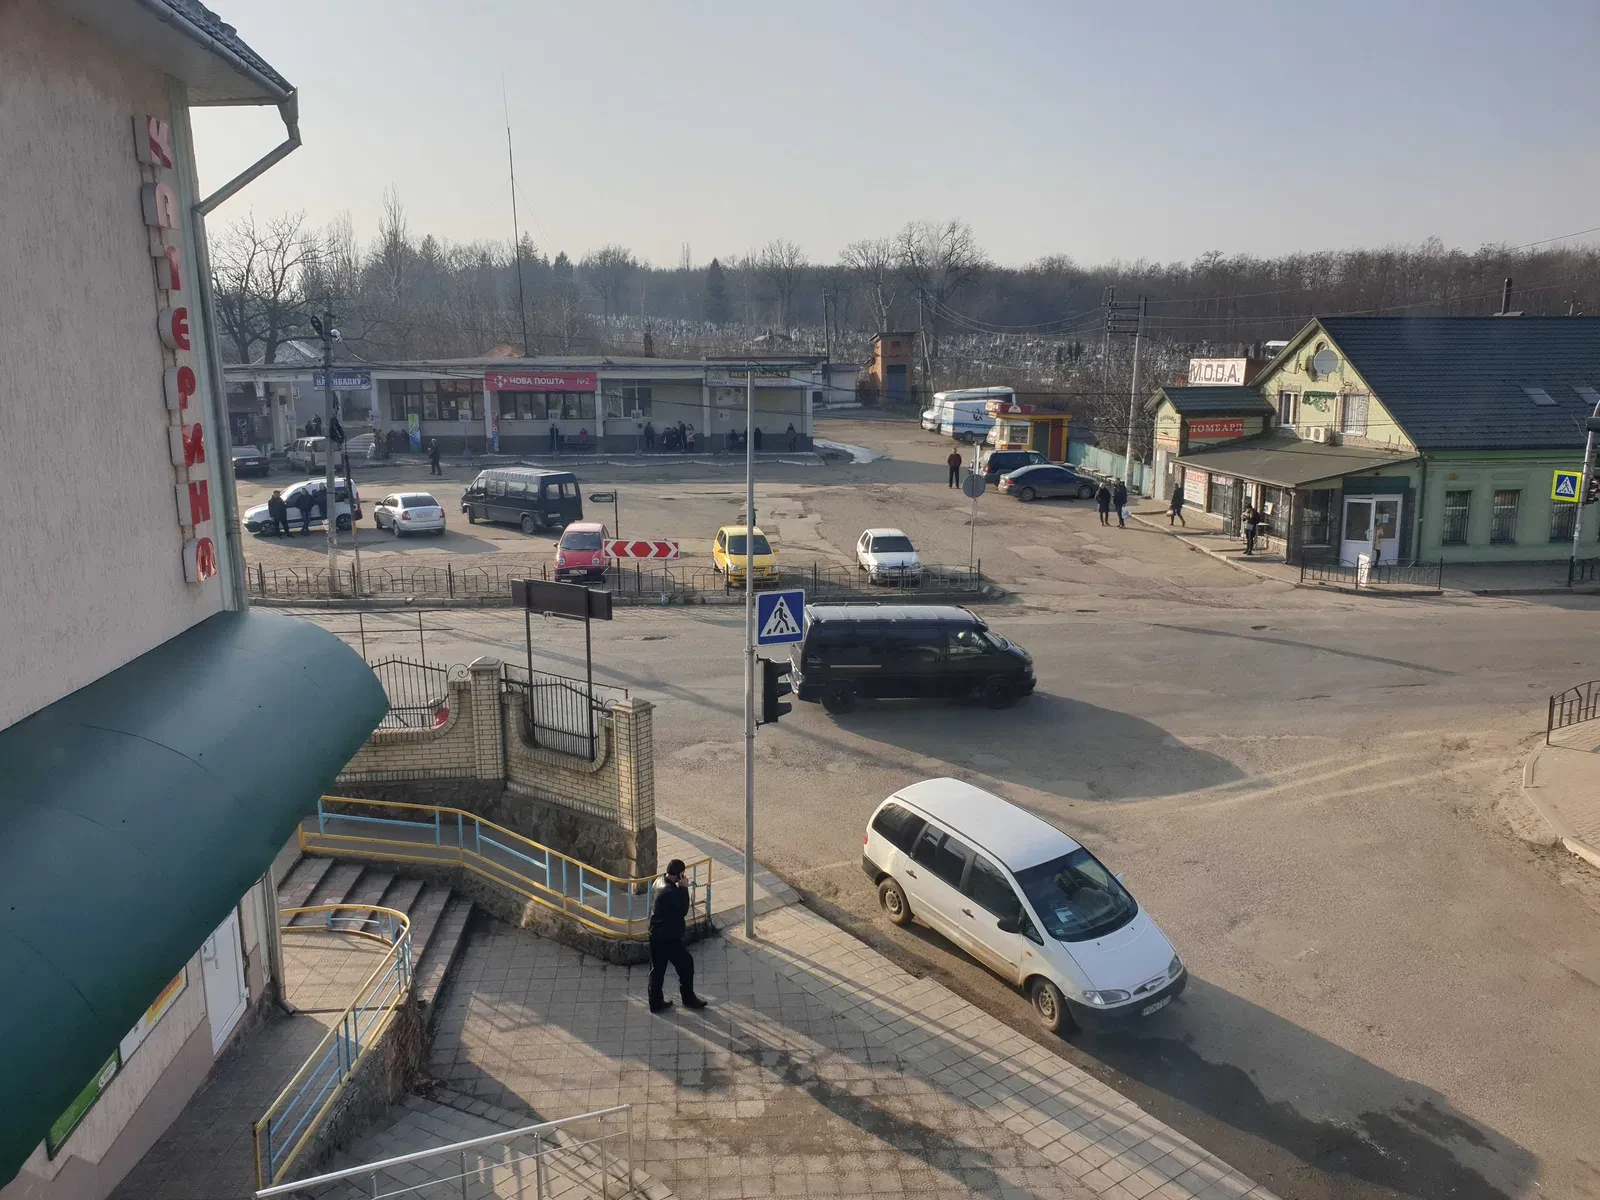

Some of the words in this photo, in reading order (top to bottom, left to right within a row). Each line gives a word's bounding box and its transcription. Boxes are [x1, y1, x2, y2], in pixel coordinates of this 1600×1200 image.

[330, 378, 362, 386] ИБАЛКУ
[509, 377, 533, 385] НОВА
[534, 377, 565, 385] ПОШТА
[576, 377, 590, 385] №2
[1189, 423, 1243, 434] ЛОМБАРД
